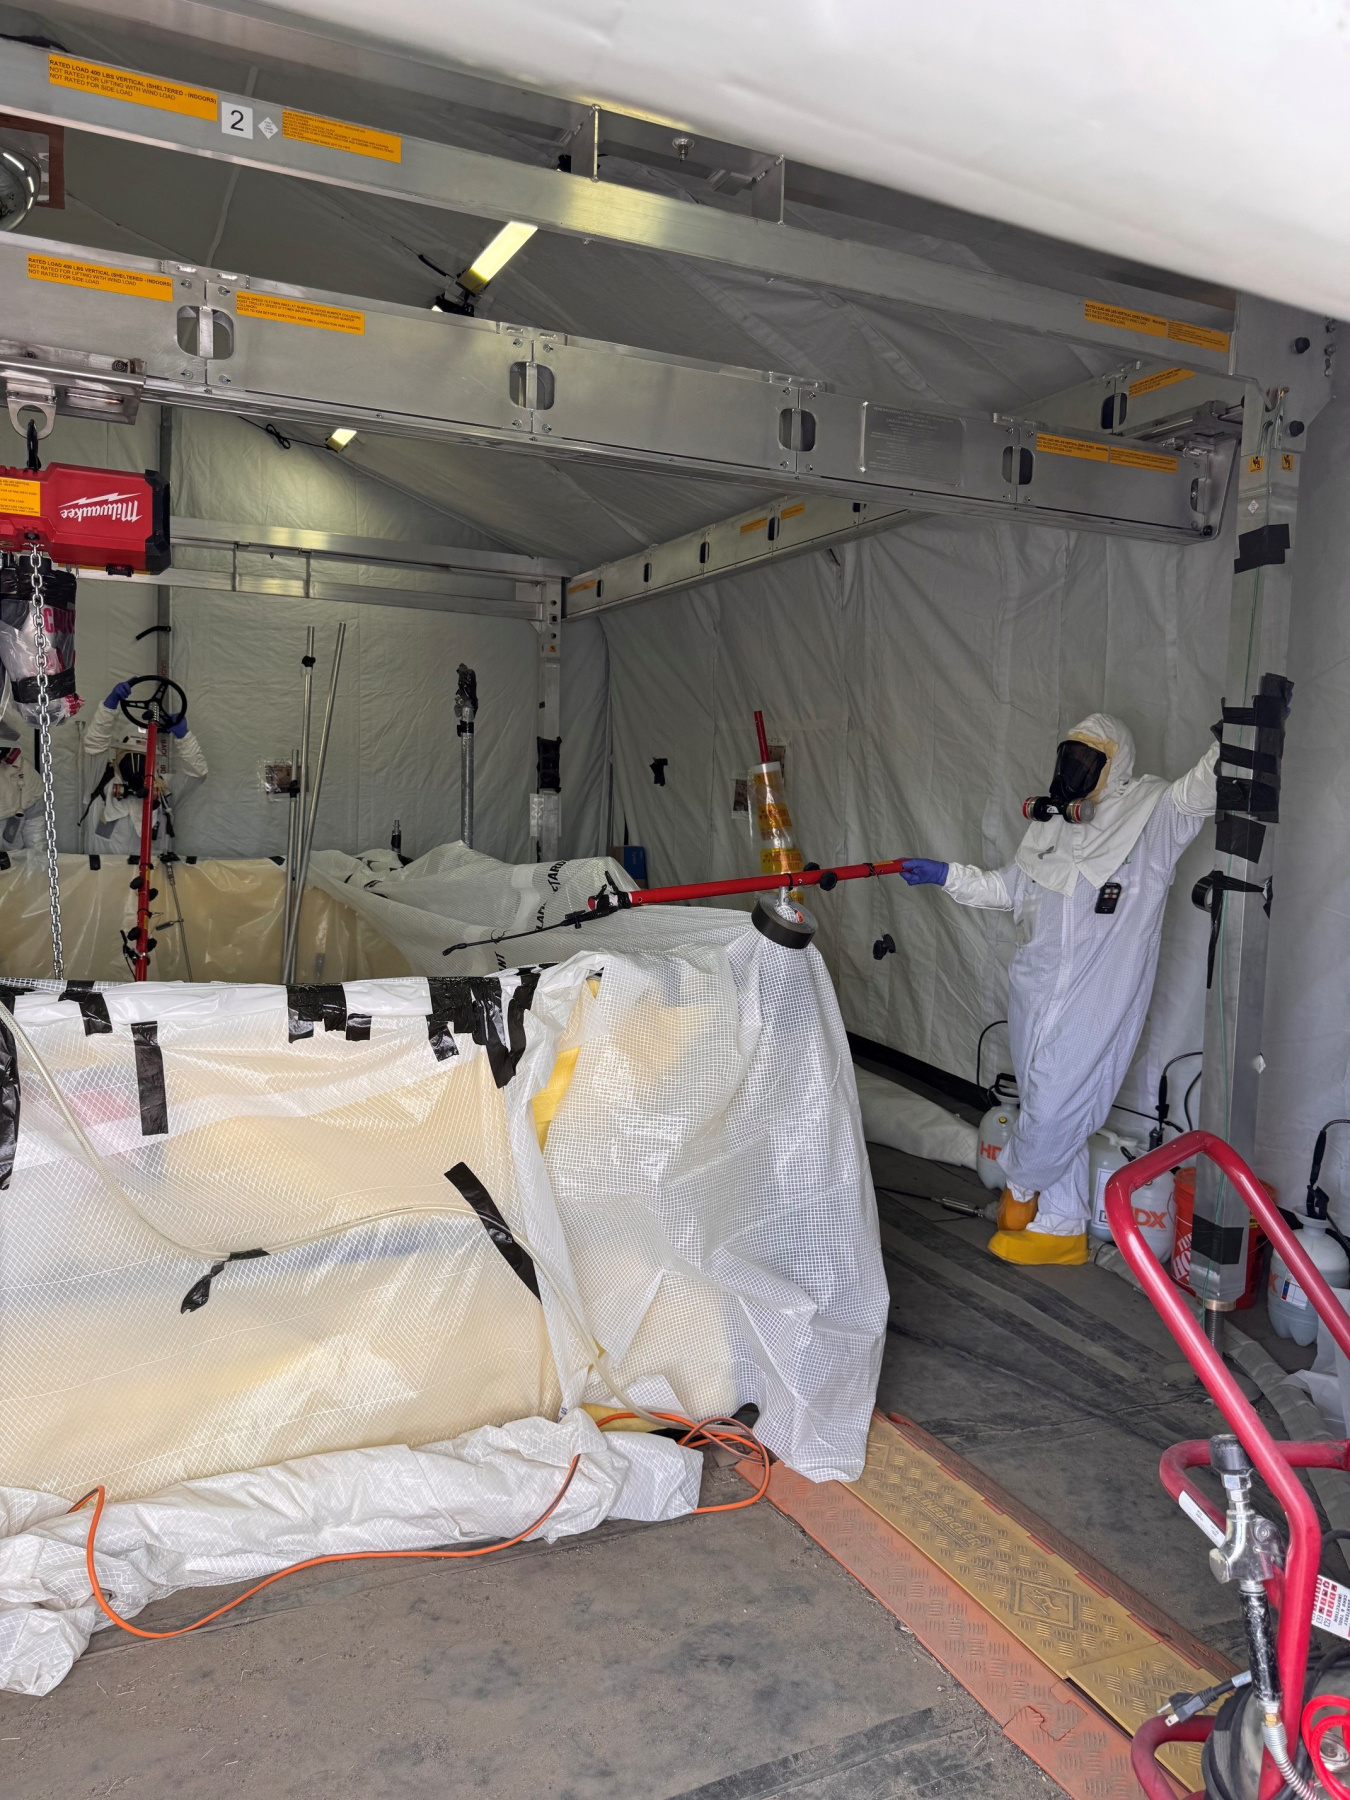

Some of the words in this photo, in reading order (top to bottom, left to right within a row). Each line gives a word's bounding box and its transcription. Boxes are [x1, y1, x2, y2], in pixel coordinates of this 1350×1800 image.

[50, 60, 70, 69] RATED
[72, 65, 89, 73] LOAD
[102, 72, 114, 80] LBS
[116, 76, 144, 86] VERTICAL
[146, 82, 184, 96] (SHELTERED
[188, 92, 216, 104] INDOORS)
[64, 70, 85, 79] RATED
[101, 79, 124, 88] LIFTING
[125, 84, 140, 92] WITH
[142, 88, 158, 96] WIND
[160, 92, 175, 100] LOAD
[64, 76, 85, 85] RATED
[116, 88, 132, 96] LOAD
[230, 110, 244, 131] 2
[85, 267, 109, 277] VERTICAL
[60, 500, 143, 523] Milwaukee
[980, 1141, 1002, 1160] HD
[1133, 1207, 1167, 1229] DX
